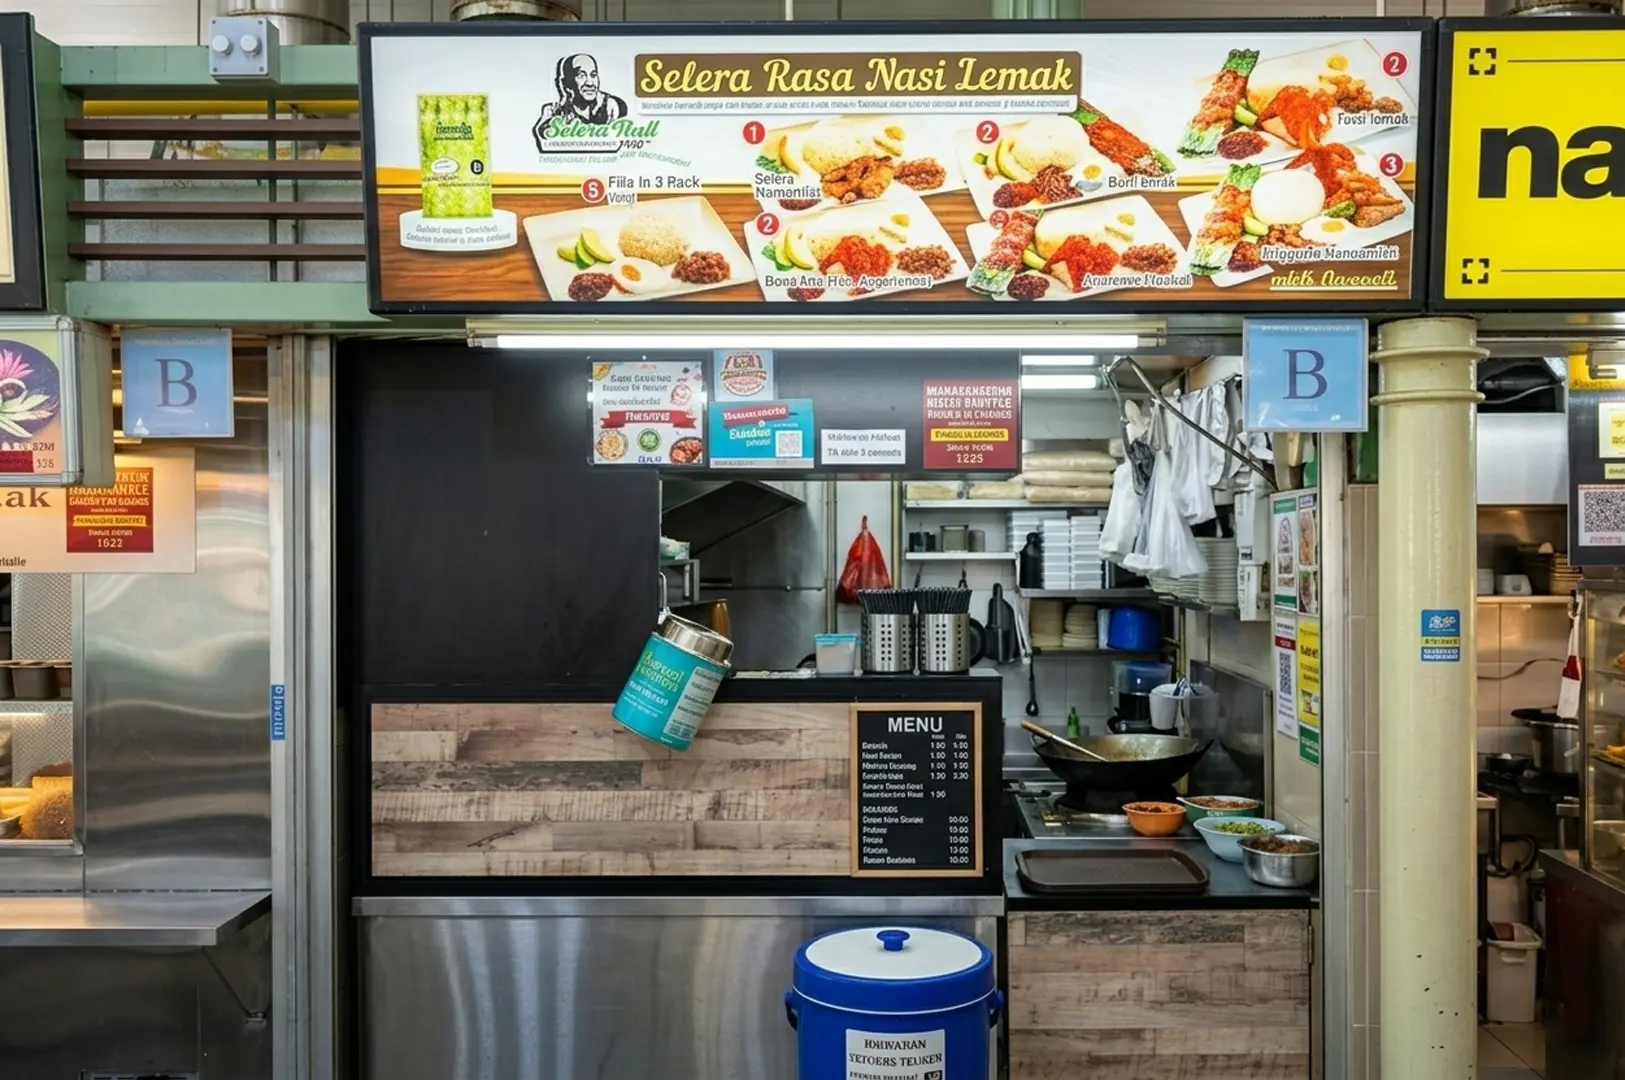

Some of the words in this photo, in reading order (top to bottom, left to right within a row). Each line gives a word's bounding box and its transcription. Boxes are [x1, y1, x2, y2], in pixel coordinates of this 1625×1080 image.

[1389, 56, 1399, 73] 2
[640, 59, 753, 94] Selera
[763, 58, 855, 93] Rasa
[865, 57, 946, 92] Nasi
[955, 56, 1074, 92] Lemak
[750, 125, 758, 141] 1
[980, 124, 993, 142] 2
[1385, 156, 1397, 173] 3
[655, 176, 663, 188] 3
[755, 173, 795, 185] Selera
[763, 217, 774, 233] 2
[154, 358, 198, 407] B
[1282, 349, 1328, 400] B
[887, 716, 943, 733] MENU
